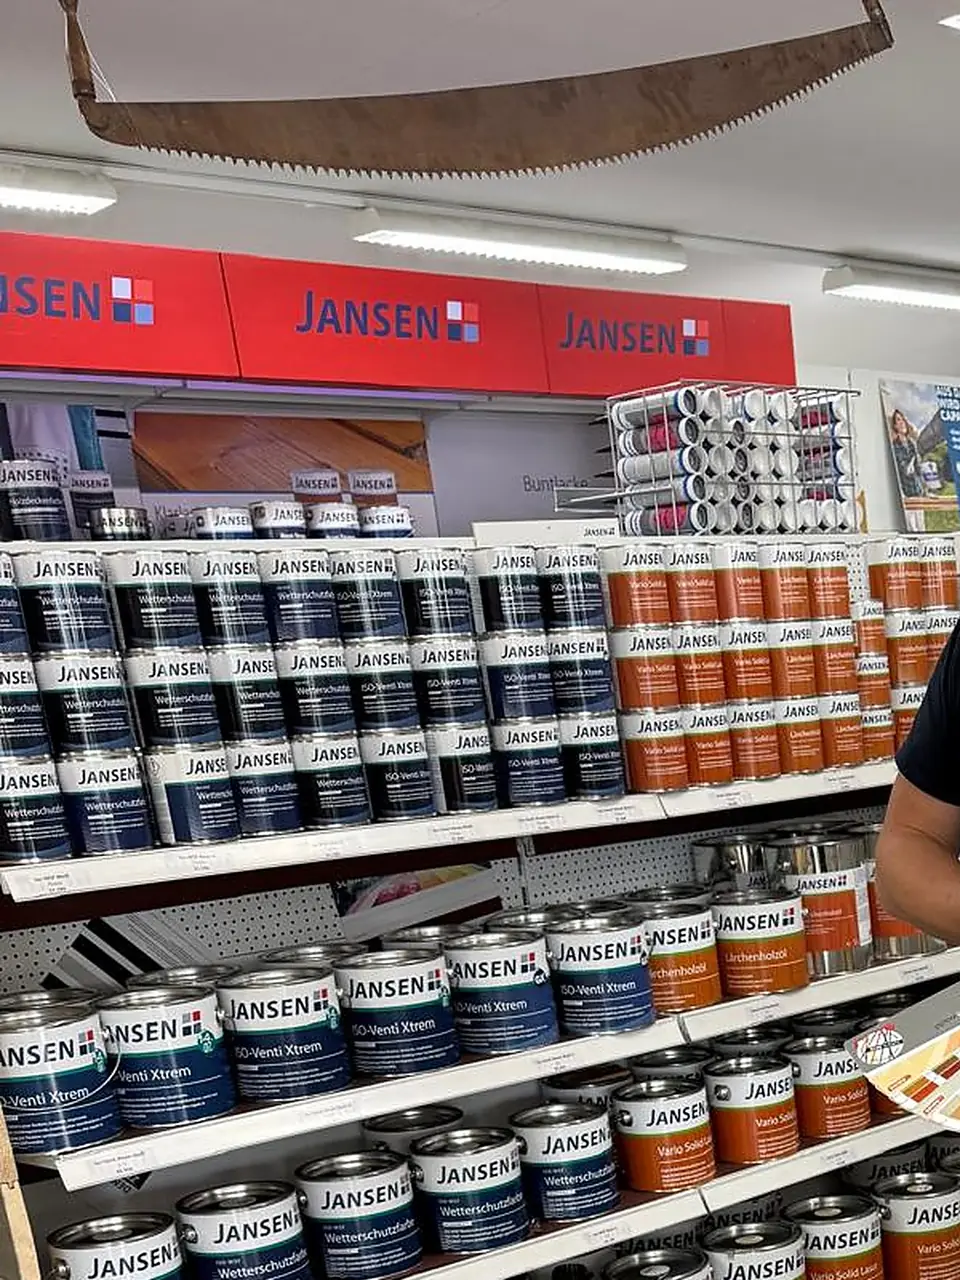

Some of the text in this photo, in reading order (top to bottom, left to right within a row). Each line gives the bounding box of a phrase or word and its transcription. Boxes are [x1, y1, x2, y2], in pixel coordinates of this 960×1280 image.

[296, 290, 438, 340] JANSEN
[559, 312, 676, 355] JANSEN
[1, 467, 50, 482] JANSEN
[421, 649, 469, 664] JANSEN
[548, 642, 595, 655] JANSEN
[58, 665, 117, 683] JANSEN
[148, 661, 205, 679] JANSEN
[505, 731, 553, 745] JANSEN
[234, 752, 288, 771] JANSEN
[78, 767, 136, 786] JANSEN
[797, 878, 837, 891] JANSEN
[718, 913, 779, 932] JANSEN
[556, 940, 628, 962] JANSEN
[725, 948, 788, 963] Lärchenholzöl
[349, 976, 424, 999] JANSEN
[604, 979, 636, 994] Xtrem
[231, 997, 309, 1020] JANSEN
[401, 1018, 436, 1035] Xtrem
[285, 1040, 323, 1057] Xtrem
[151, 1067, 191, 1081] Xtrem
[50, 1087, 89, 1104] Xtrem
[647, 1102, 705, 1127] JANSEN
[658, 1143, 682, 1157] Vario
[437, 1159, 507, 1185] JANSEN
[321, 1182, 398, 1210] JANSEN
[213, 1211, 293, 1244] JANSEN
[805, 1228, 870, 1251] JANSEN
[917, 1241, 941, 1254] Vario
[87, 1244, 172, 1280] JANSEN
[836, 1268, 859, 1279] Solid
